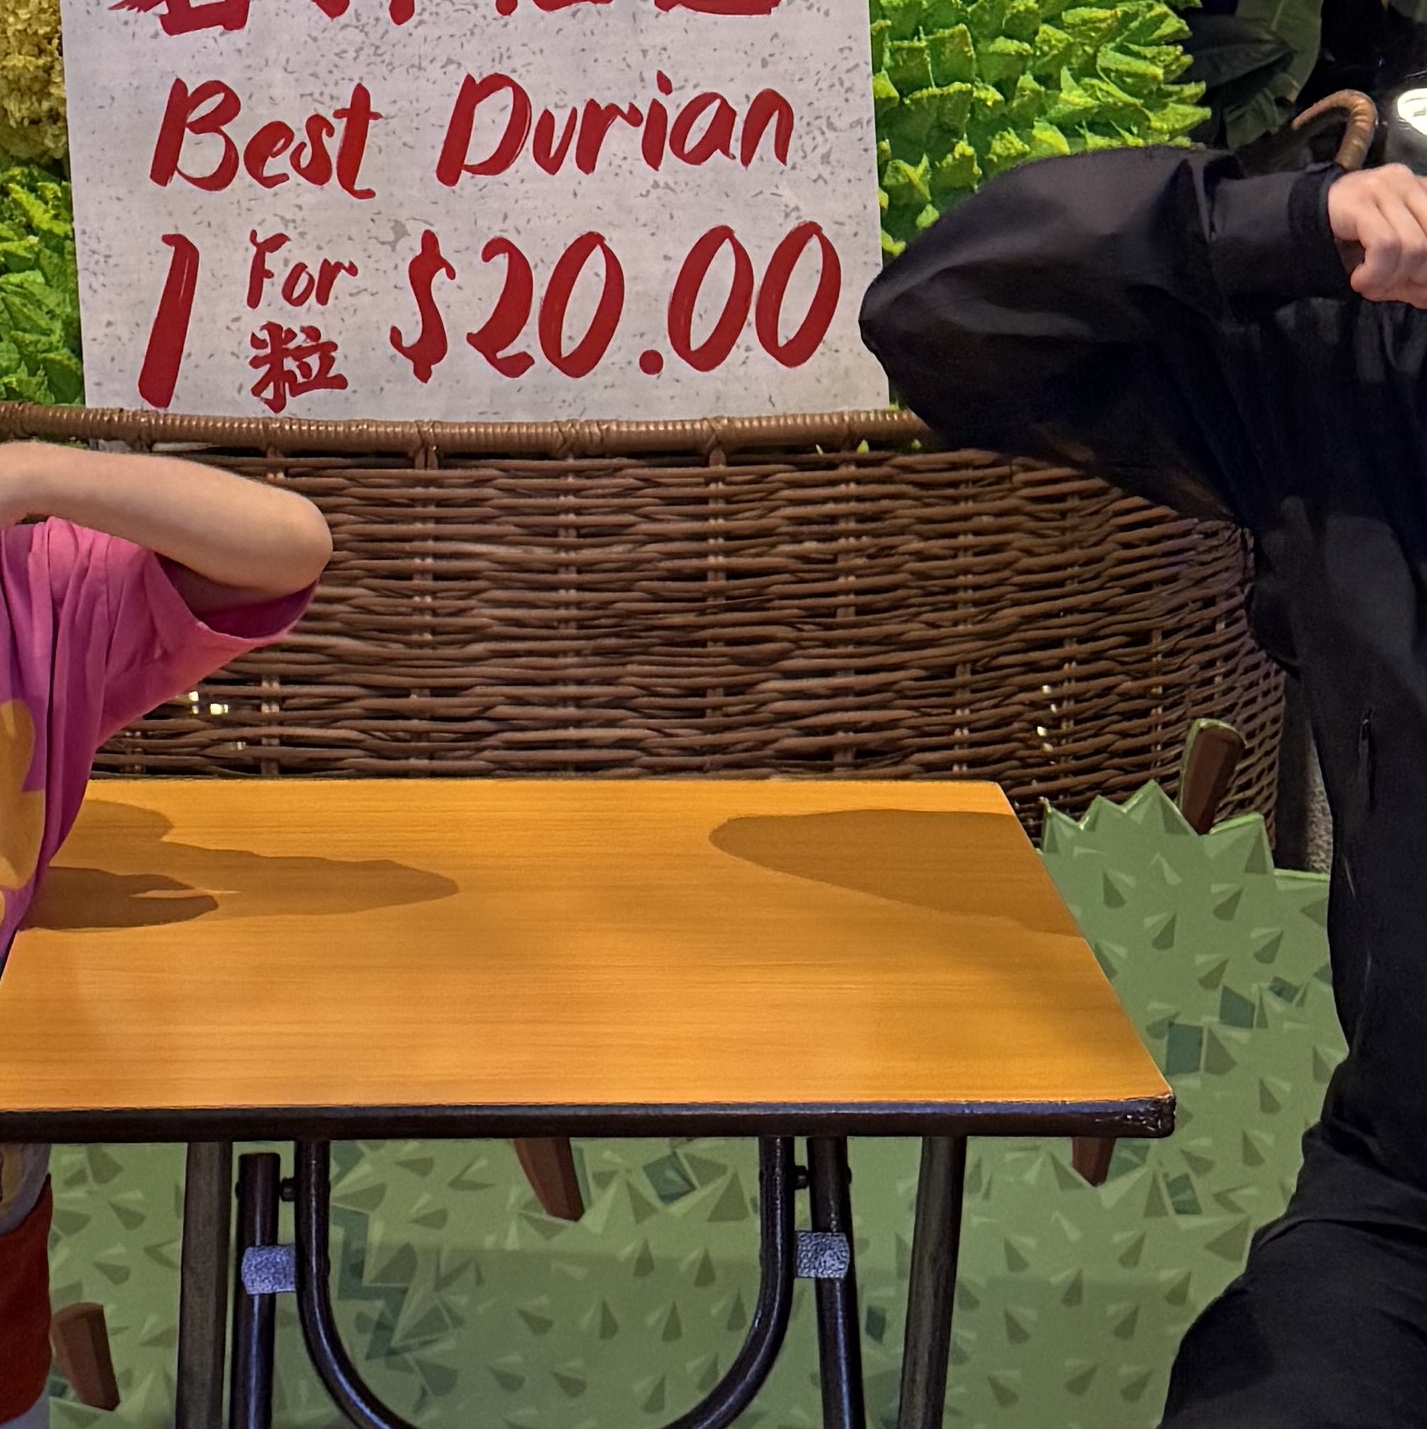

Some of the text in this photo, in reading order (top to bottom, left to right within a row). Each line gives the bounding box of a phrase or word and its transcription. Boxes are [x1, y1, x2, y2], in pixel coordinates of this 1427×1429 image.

[148, 70, 796, 201] Best Durian
[136, 221, 842, 410] 1 For $20.00
[247, 322, 349, 415] 粒
